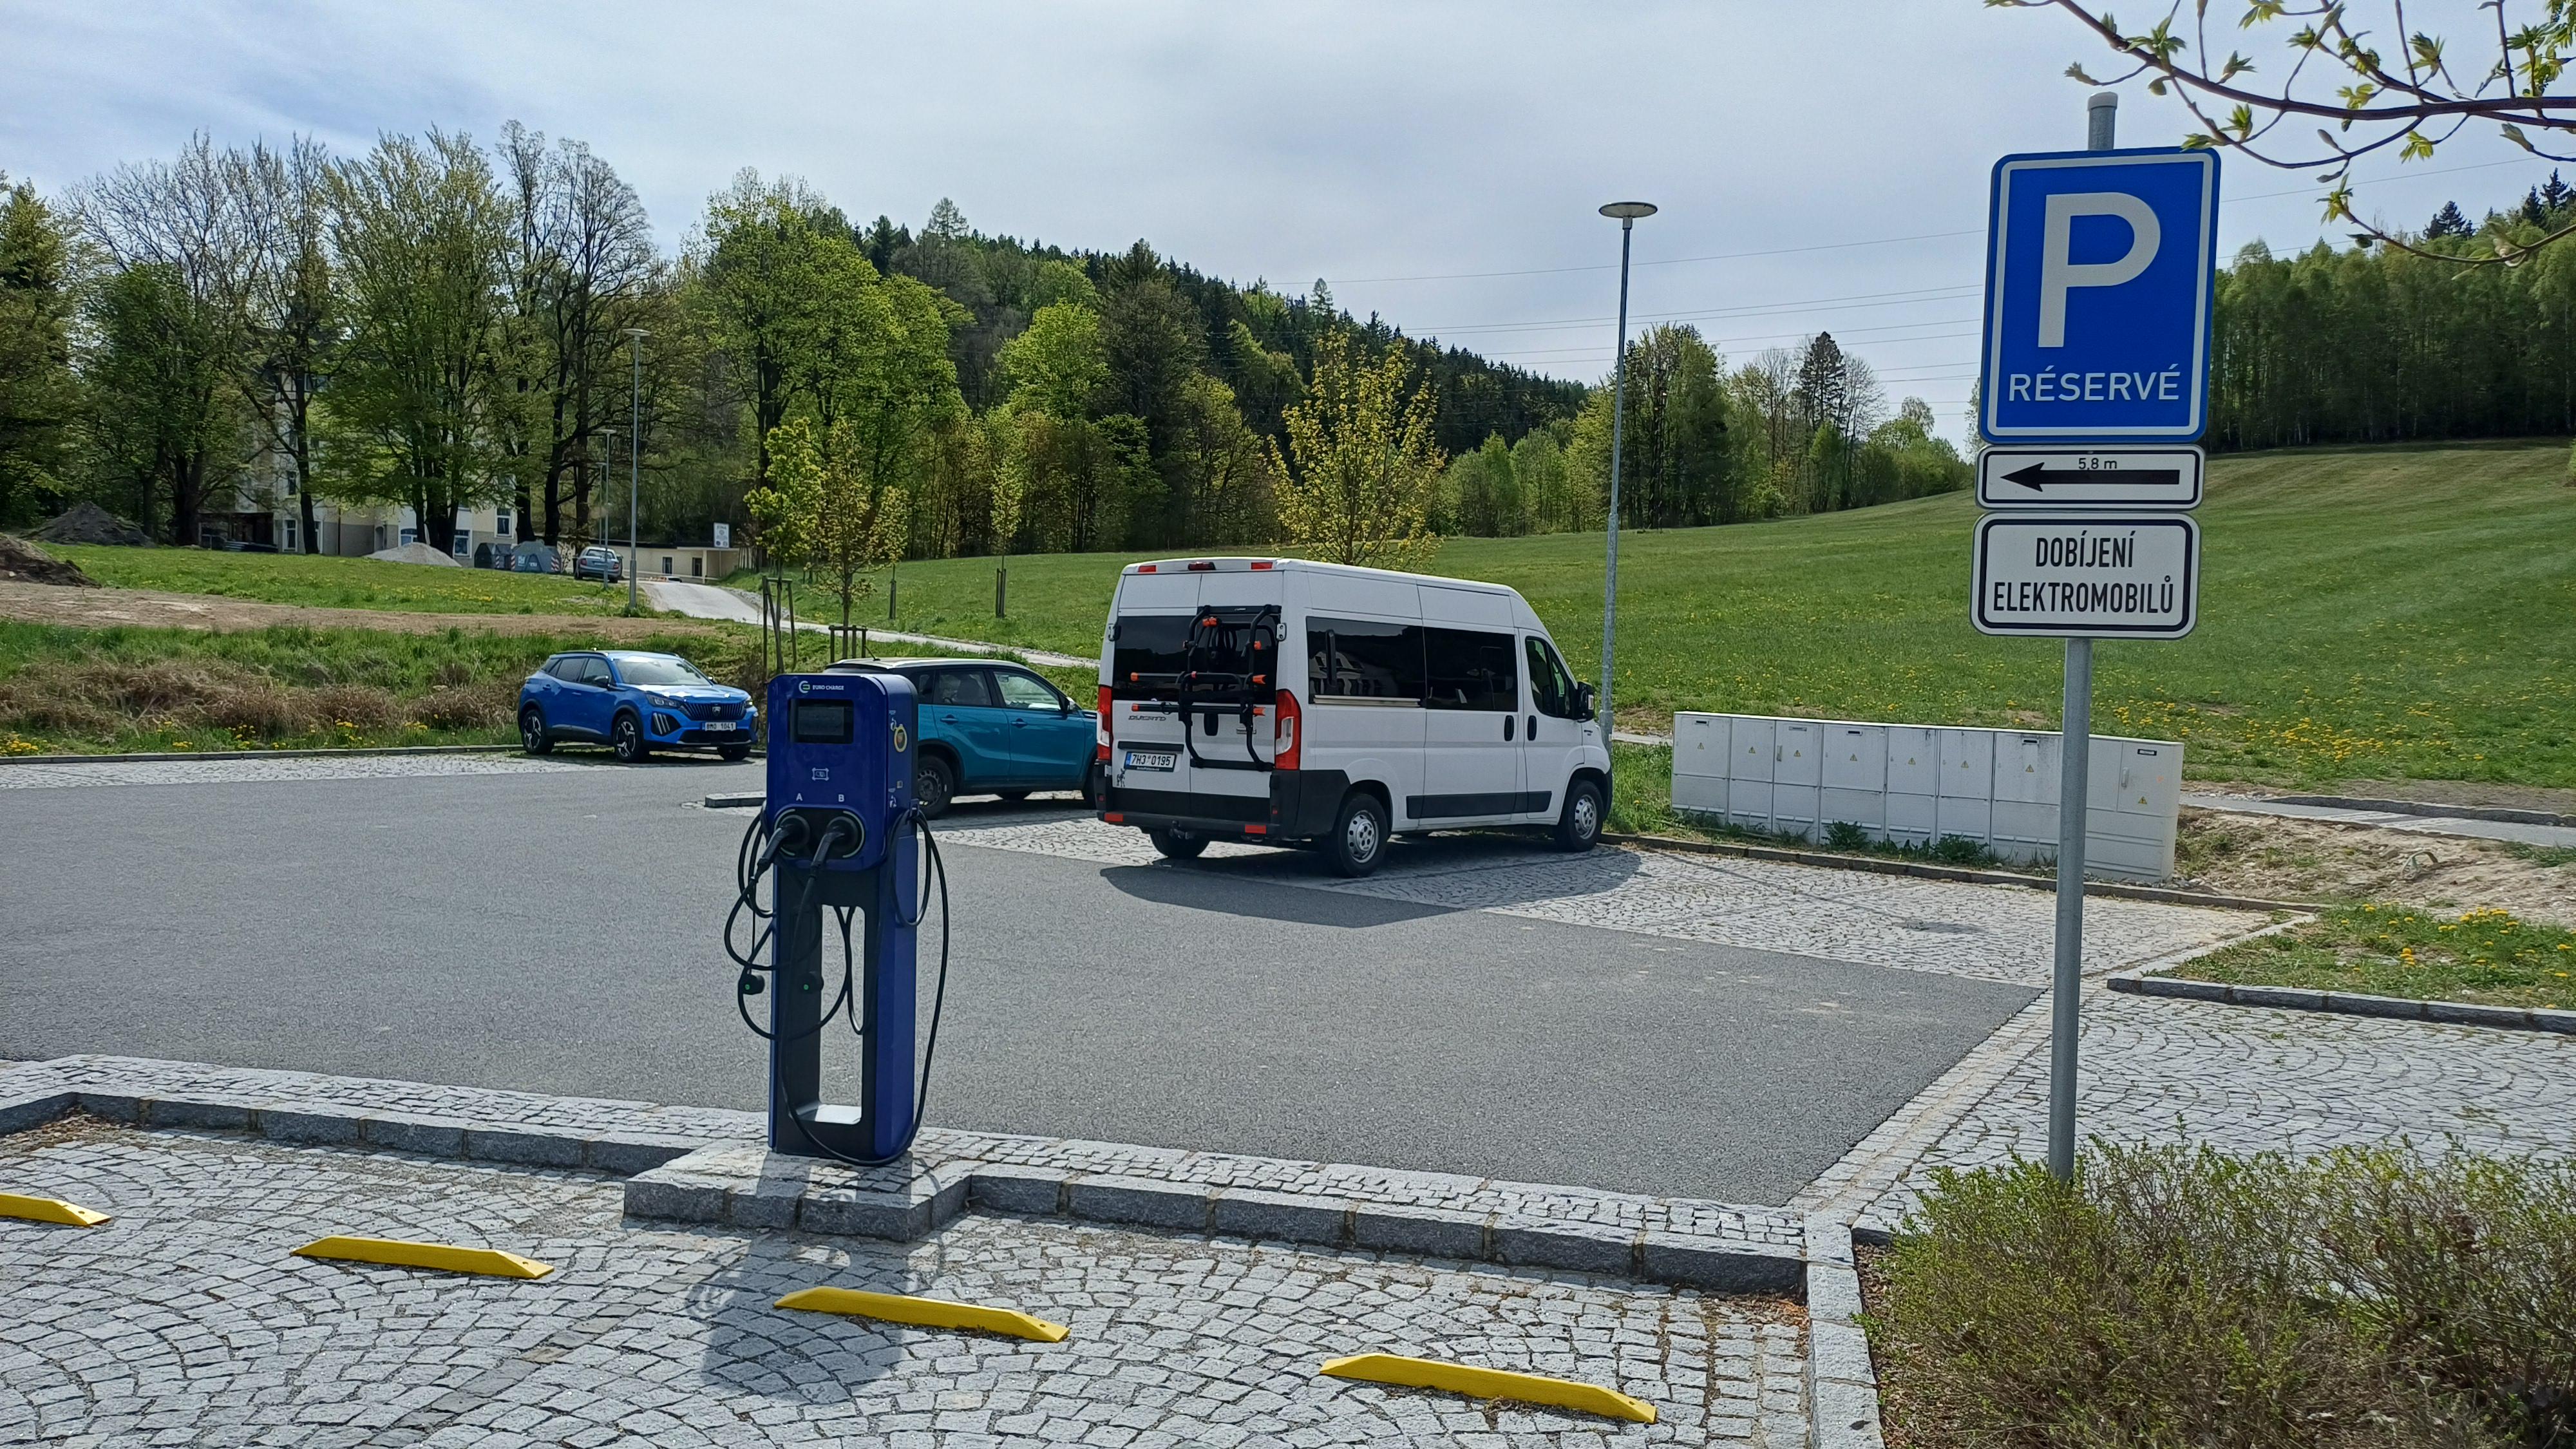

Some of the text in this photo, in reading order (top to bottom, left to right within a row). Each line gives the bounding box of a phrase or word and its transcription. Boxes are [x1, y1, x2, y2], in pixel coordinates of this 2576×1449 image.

[2038, 192, 2161, 348] P
[2009, 364, 2181, 401] RÉSERVÉ
[2079, 457, 2117, 471] 5,8 m
[2036, 530, 2136, 568] DOBÍJENÍ
[1993, 575, 2174, 614] ELEKTROMOBILŮ
[1132, 754, 1171, 766] 7H3 0195
[796, 793, 803, 801] A
